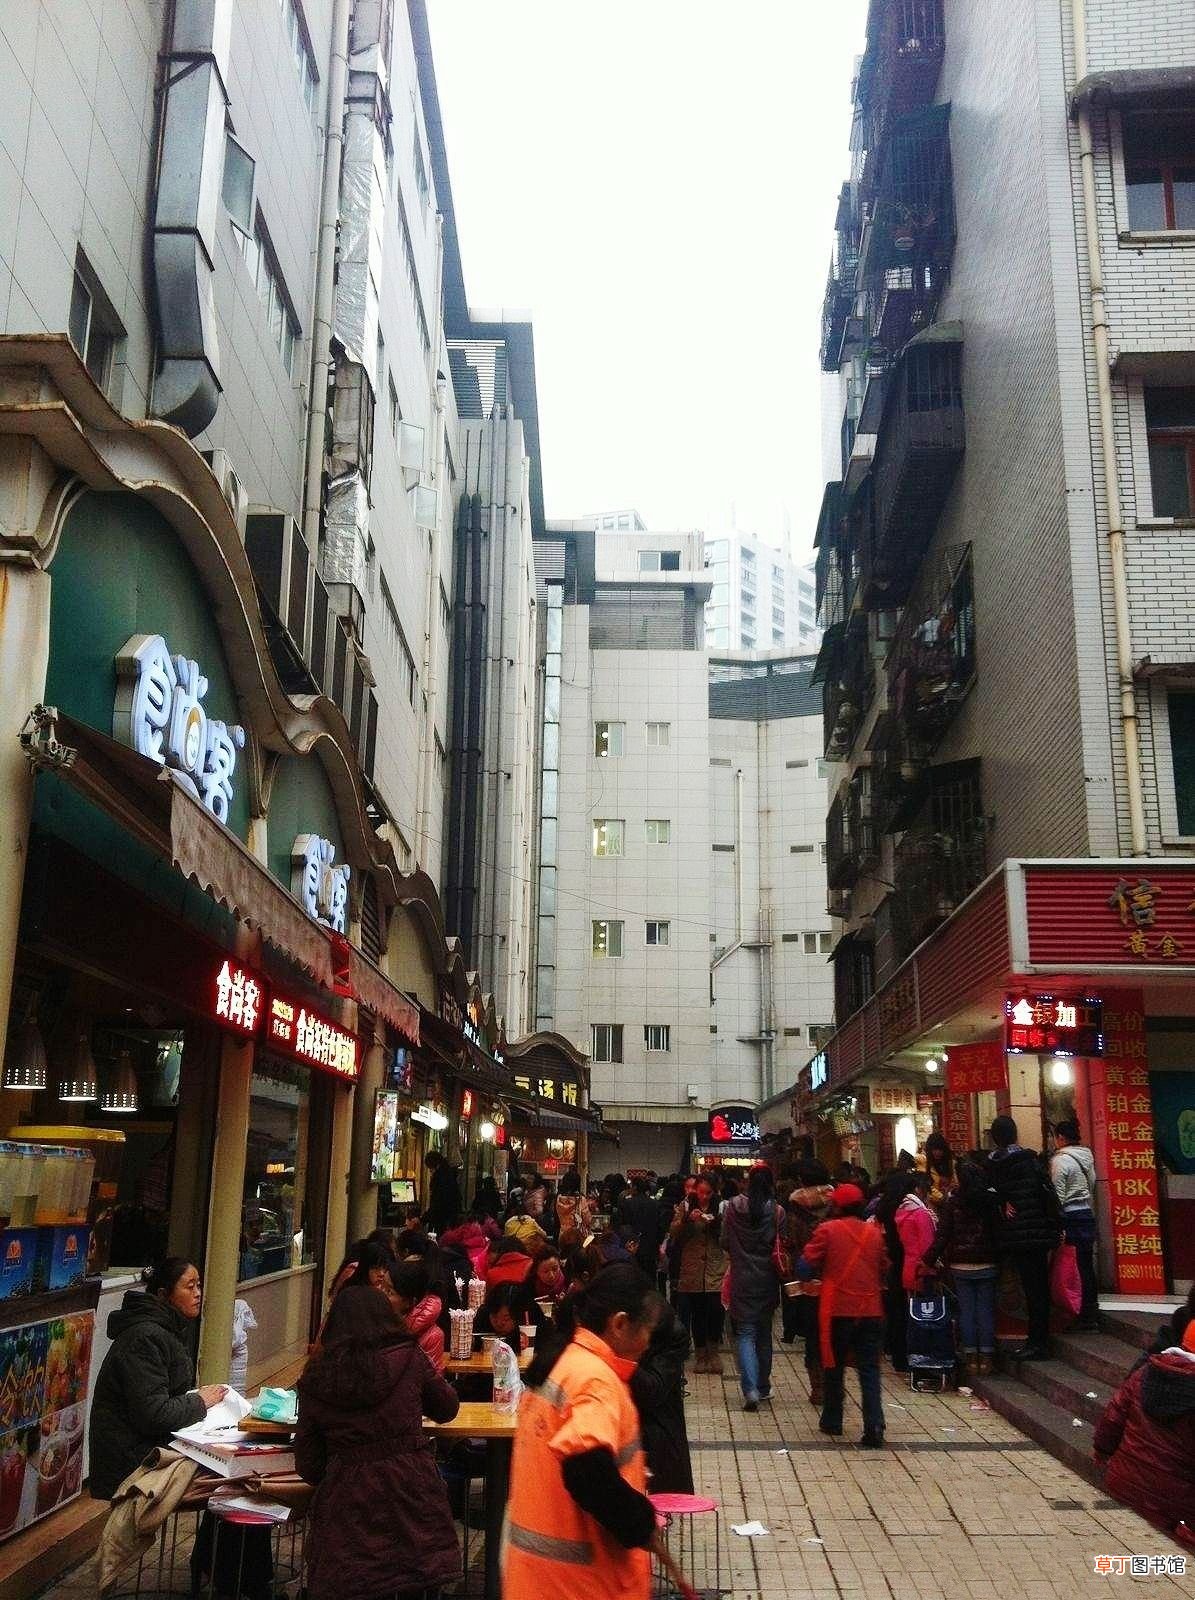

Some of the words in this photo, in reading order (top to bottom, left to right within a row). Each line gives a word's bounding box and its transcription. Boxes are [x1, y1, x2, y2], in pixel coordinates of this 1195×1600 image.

[1122, 929, 1185, 959] 黄金
[216, 960, 261, 1031] 食尚客
[1103, 1010, 1145, 1032] 高价
[1105, 1040, 1148, 1058] 回收
[1105, 1064, 1150, 1086] 黄金
[1107, 1092, 1152, 1114] 铂金
[1108, 1120, 1155, 1142] 钯金
[1110, 1148, 1157, 1170] 钻戒
[1113, 1178, 1153, 1196] 18K
[1114, 1204, 1160, 1228] 沙金
[1117, 1233, 1163, 1256] 提纯
